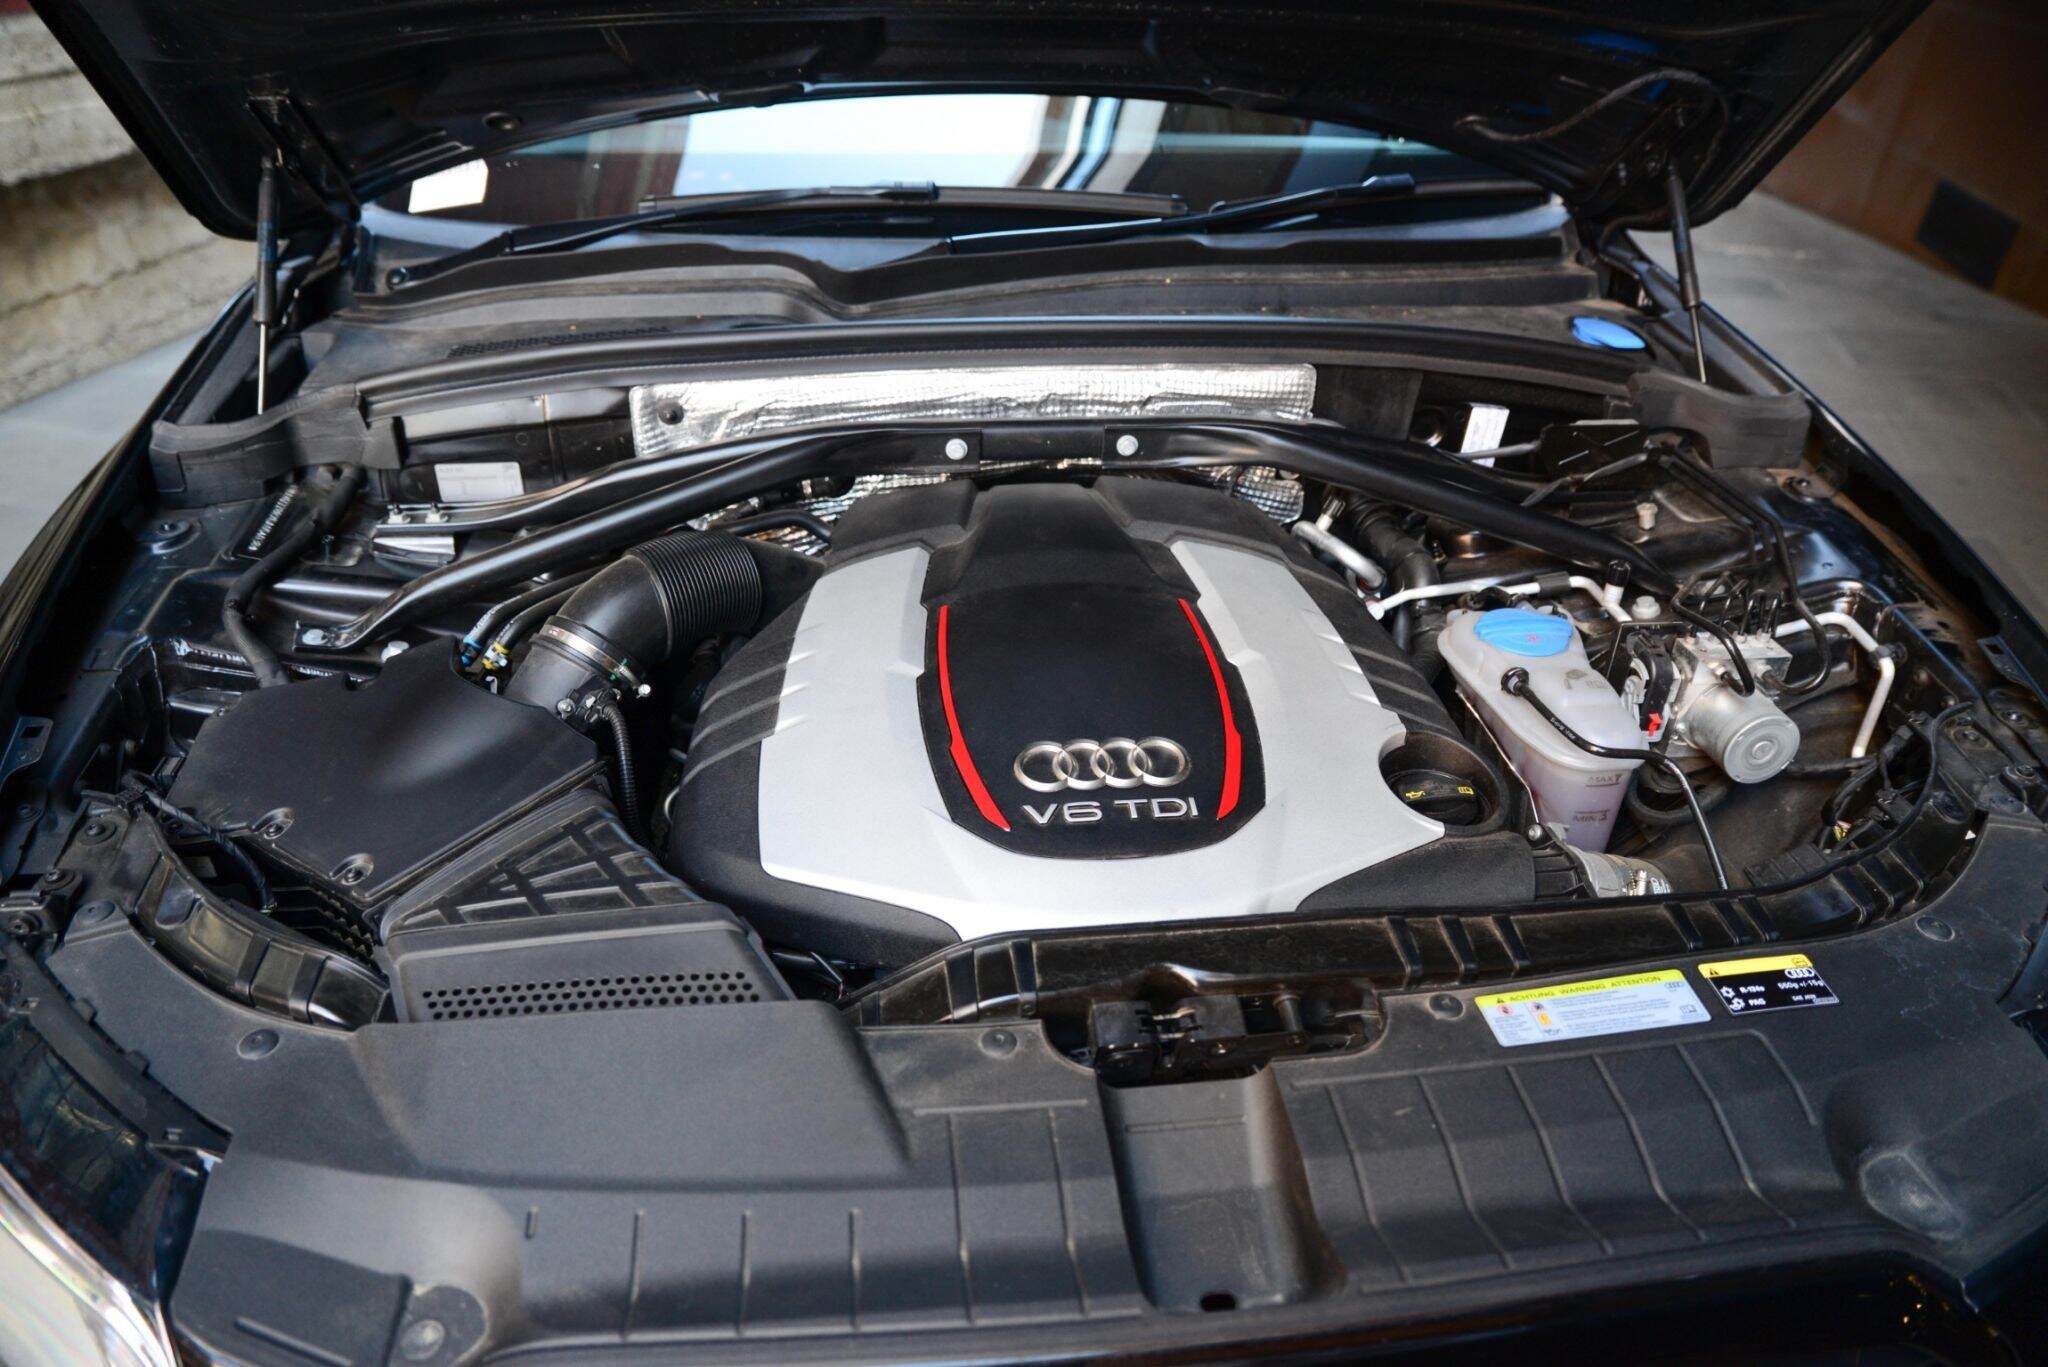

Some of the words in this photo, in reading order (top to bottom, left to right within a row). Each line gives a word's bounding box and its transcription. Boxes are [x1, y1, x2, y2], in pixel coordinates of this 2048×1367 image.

[1022, 801, 1103, 824] V6
[1113, 796, 1199, 819] TDI
[1509, 990, 1555, 1001] ACHTUNG
[1559, 983, 1606, 995] WARNING
[1610, 976, 1662, 988] ATTENTION
